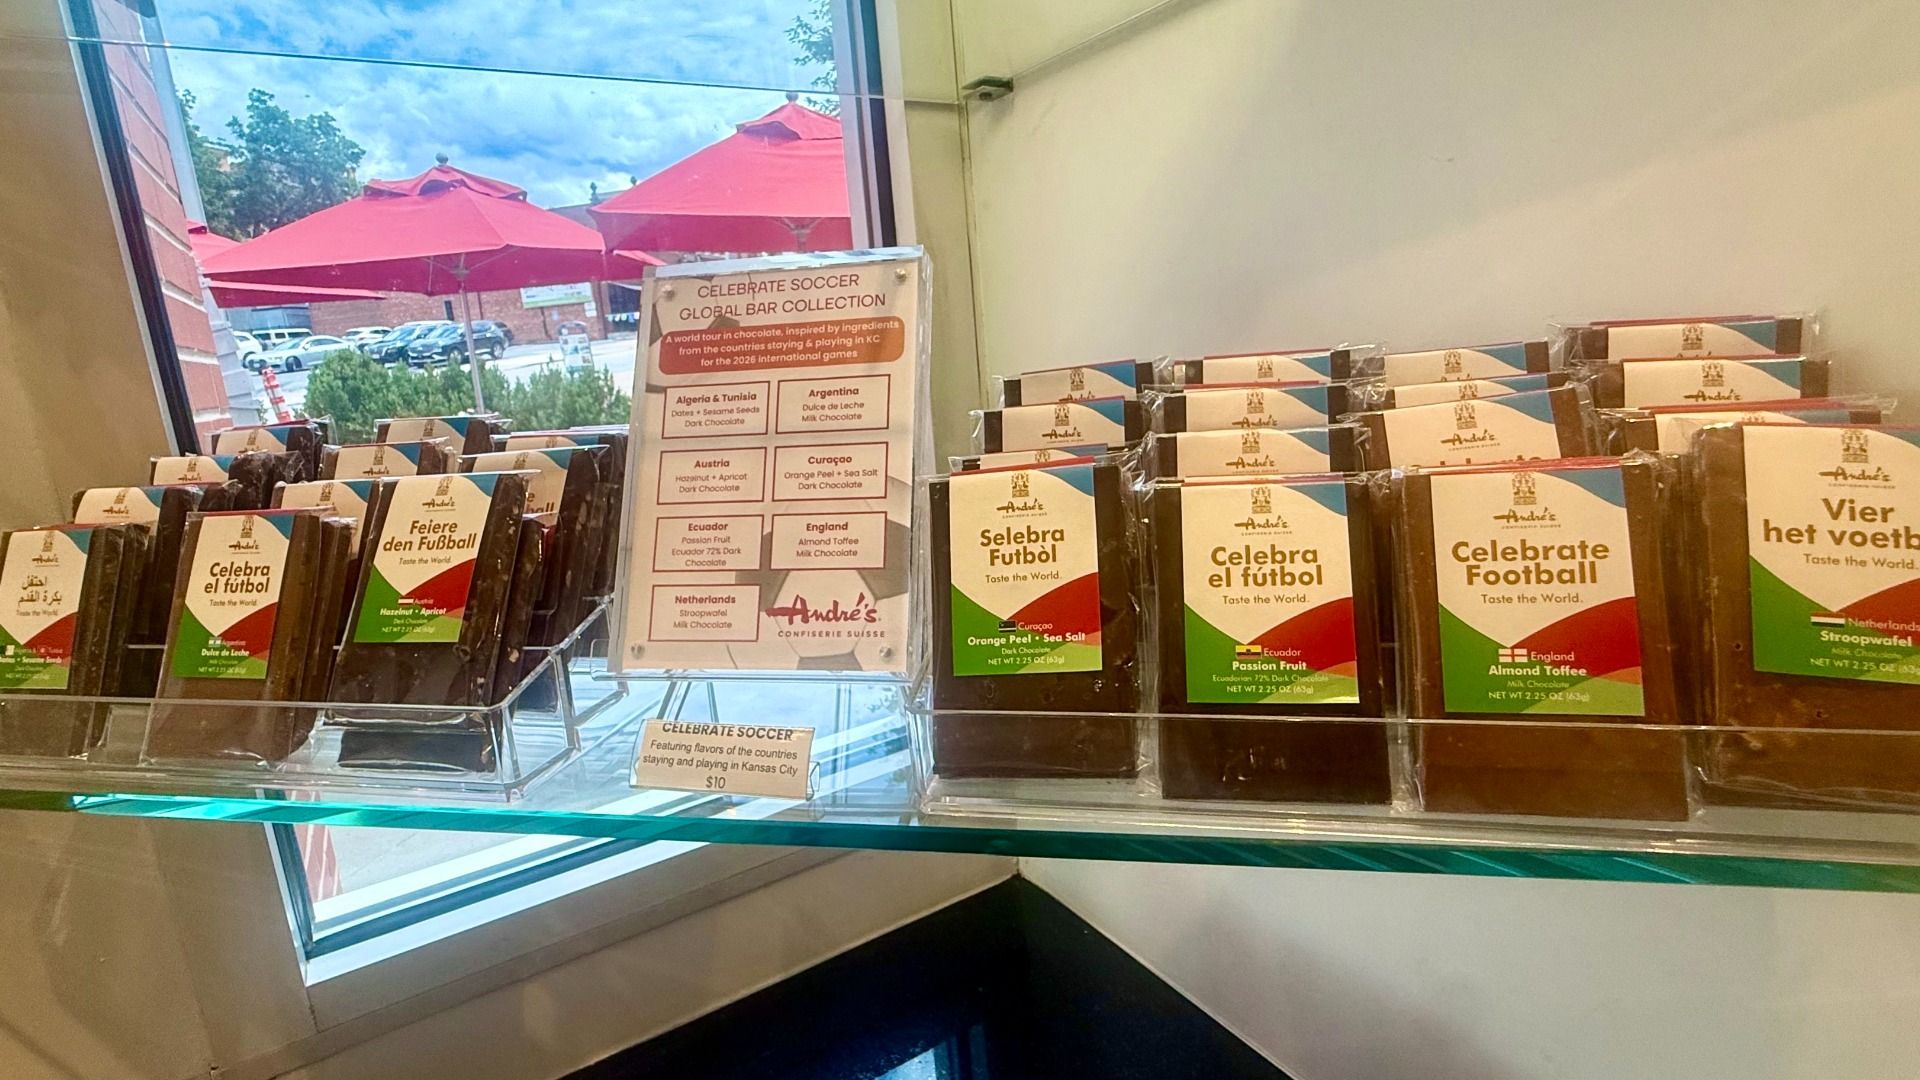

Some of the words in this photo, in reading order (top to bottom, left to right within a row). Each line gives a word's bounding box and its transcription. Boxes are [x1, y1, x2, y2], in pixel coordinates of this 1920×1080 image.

[698, 280, 786, 298] CELEBRATE
[790, 274, 860, 291] SOCCER
[680, 304, 742, 320] GLOBAL
[746, 302, 777, 315] BAR
[782, 294, 886, 312] COLLECTION
[665, 335, 672, 343] A
[674, 334, 700, 343] world
[702, 333, 721, 341] tour
[723, 332, 732, 340] in
[786, 325, 825, 336] inspired
[827, 324, 840, 334] by
[841, 320, 899, 333] ingredients
[679, 347, 701, 355] from
[703, 345, 718, 353] the
[720, 342, 765, 352] countries
[767, 339, 804, 350] staying
[805, 339, 813, 348] &
[815, 336, 853, 348] playing
[855, 336, 864, 344] in
[866, 335, 880, 343] KC
[715, 357, 731, 365] the
[733, 356, 756, 364] 2026
[758, 352, 820, 363] international
[822, 350, 858, 361] games
[676, 394, 711, 406] Algeria
[712, 394, 720, 403] &
[721, 392, 757, 402] Tunisia
[808, 387, 859, 399] Argentina
[671, 409, 694, 417] Dates
[703, 408, 734, 416] Sesame
[736, 406, 760, 414] Seeds
[802, 403, 826, 411] Dulce
[827, 402, 838, 410] de
[704, 418, 745, 426] Chocolate
[801, 414, 816, 422] Milk
[818, 413, 862, 421] Chocolate
[694, 458, 730, 468] Austria
[808, 456, 852, 466] Curaçao
[675, 474, 710, 482] Hazelnut
[718, 473, 747, 482] Apricot
[784, 471, 815, 480] Orange
[817, 470, 834, 478] Peel
[1818, 466, 1891, 482] André's
[679, 485, 696, 493] Dark
[698, 484, 740, 492] Chocolate
[798, 482, 817, 490] Dark
[819, 481, 863, 489] Chocolate
[1493, 507, 1556, 523] André's
[1821, 498, 1895, 523] Vier
[410, 518, 458, 534] Feiere
[688, 522, 728, 531] Ecuador
[806, 522, 849, 534] England
[1762, 518, 1817, 544] het
[383, 536, 413, 552] den
[418, 532, 477, 550] Fußball
[681, 536, 712, 544] Passion
[714, 536, 731, 544] Fruit
[798, 538, 831, 546] Almond
[833, 537, 860, 545] Toffee
[980, 525, 1064, 547] Selebra
[671, 547, 705, 556] Ecuador
[706, 547, 721, 555] 72%
[814, 549, 858, 557] Chocolate
[990, 544, 1056, 566] Futbòl
[1210, 544, 1318, 566] Celebra
[1452, 538, 1610, 562] Celebrate
[685, 558, 727, 567] Chocolate
[1803, 553, 1840, 566] Taste
[1845, 556, 1868, 568] the
[1872, 556, 1919, 570] World.
[210, 561, 270, 577] Celebra
[1466, 561, 1598, 586] Football
[985, 574, 1010, 584] Taste
[1012, 573, 1028, 582] the
[1208, 567, 1232, 588] el
[1241, 564, 1323, 587] fútbol
[204, 578, 219, 594] el
[224, 577, 270, 594] fútbol
[674, 595, 736, 604] Netherlands
[1222, 596, 1250, 605] Taste
[1253, 595, 1271, 604] the
[1480, 594, 1513, 604] Taste
[1516, 593, 1537, 604] the
[1540, 592, 1584, 604] World.
[380, 608, 414, 616] Hazelnut
[420, 608, 446, 616] Apricot
[679, 609, 728, 618] Stroopwafel
[765, 592, 878, 625] André's
[673, 621, 688, 629] Milk
[690, 620, 733, 628] Chocolate
[1018, 622, 1053, 631] Curaçao
[1848, 618, 1920, 632] Netherlands
[777, 630, 842, 638] CONFISERIE
[847, 630, 886, 638] SUISSE
[968, 637, 1006, 647] Orange
[1009, 634, 1032, 644] Peel
[1043, 634, 1062, 642] Sea
[1065, 632, 1086, 642] Salt
[1820, 630, 1912, 646] Stroopwafel
[201, 648, 220, 656] Dulce
[221, 648, 230, 656] de
[231, 648, 250, 657] Leche
[1263, 648, 1301, 657] Ecuador
[1530, 652, 1574, 663] England
[1232, 661, 1276, 671] Passion
[1280, 661, 1307, 670] Fruit
[1488, 665, 1540, 676] Almond
[1544, 666, 1588, 676] Toffee
[1226, 685, 1242, 693] NET
[1244, 685, 1257, 693] WT
[1258, 685, 1277, 693] 2.25
[1278, 685, 1292, 694] OZ
[1488, 692, 1506, 700] NET
[1508, 692, 1522, 700] WT
[1525, 692, 1546, 700] 2.25
[1548, 692, 1563, 700] OZ
[662, 722, 735, 737] CELEBRATE
[737, 726, 794, 741] SOCCER
[650, 739, 692, 754] Featuring
[694, 742, 724, 755] flavors
[726, 745, 736, 755] of
[738, 746, 752, 757] the
[754, 748, 798, 760] countries
[642, 754, 674, 767] staying
[676, 757, 693, 766] and
[696, 758, 728, 772] playing
[730, 760, 739, 770] in
[741, 761, 776, 774] Kansas
[779, 764, 798, 778] City
[705, 776, 726, 789] $10
